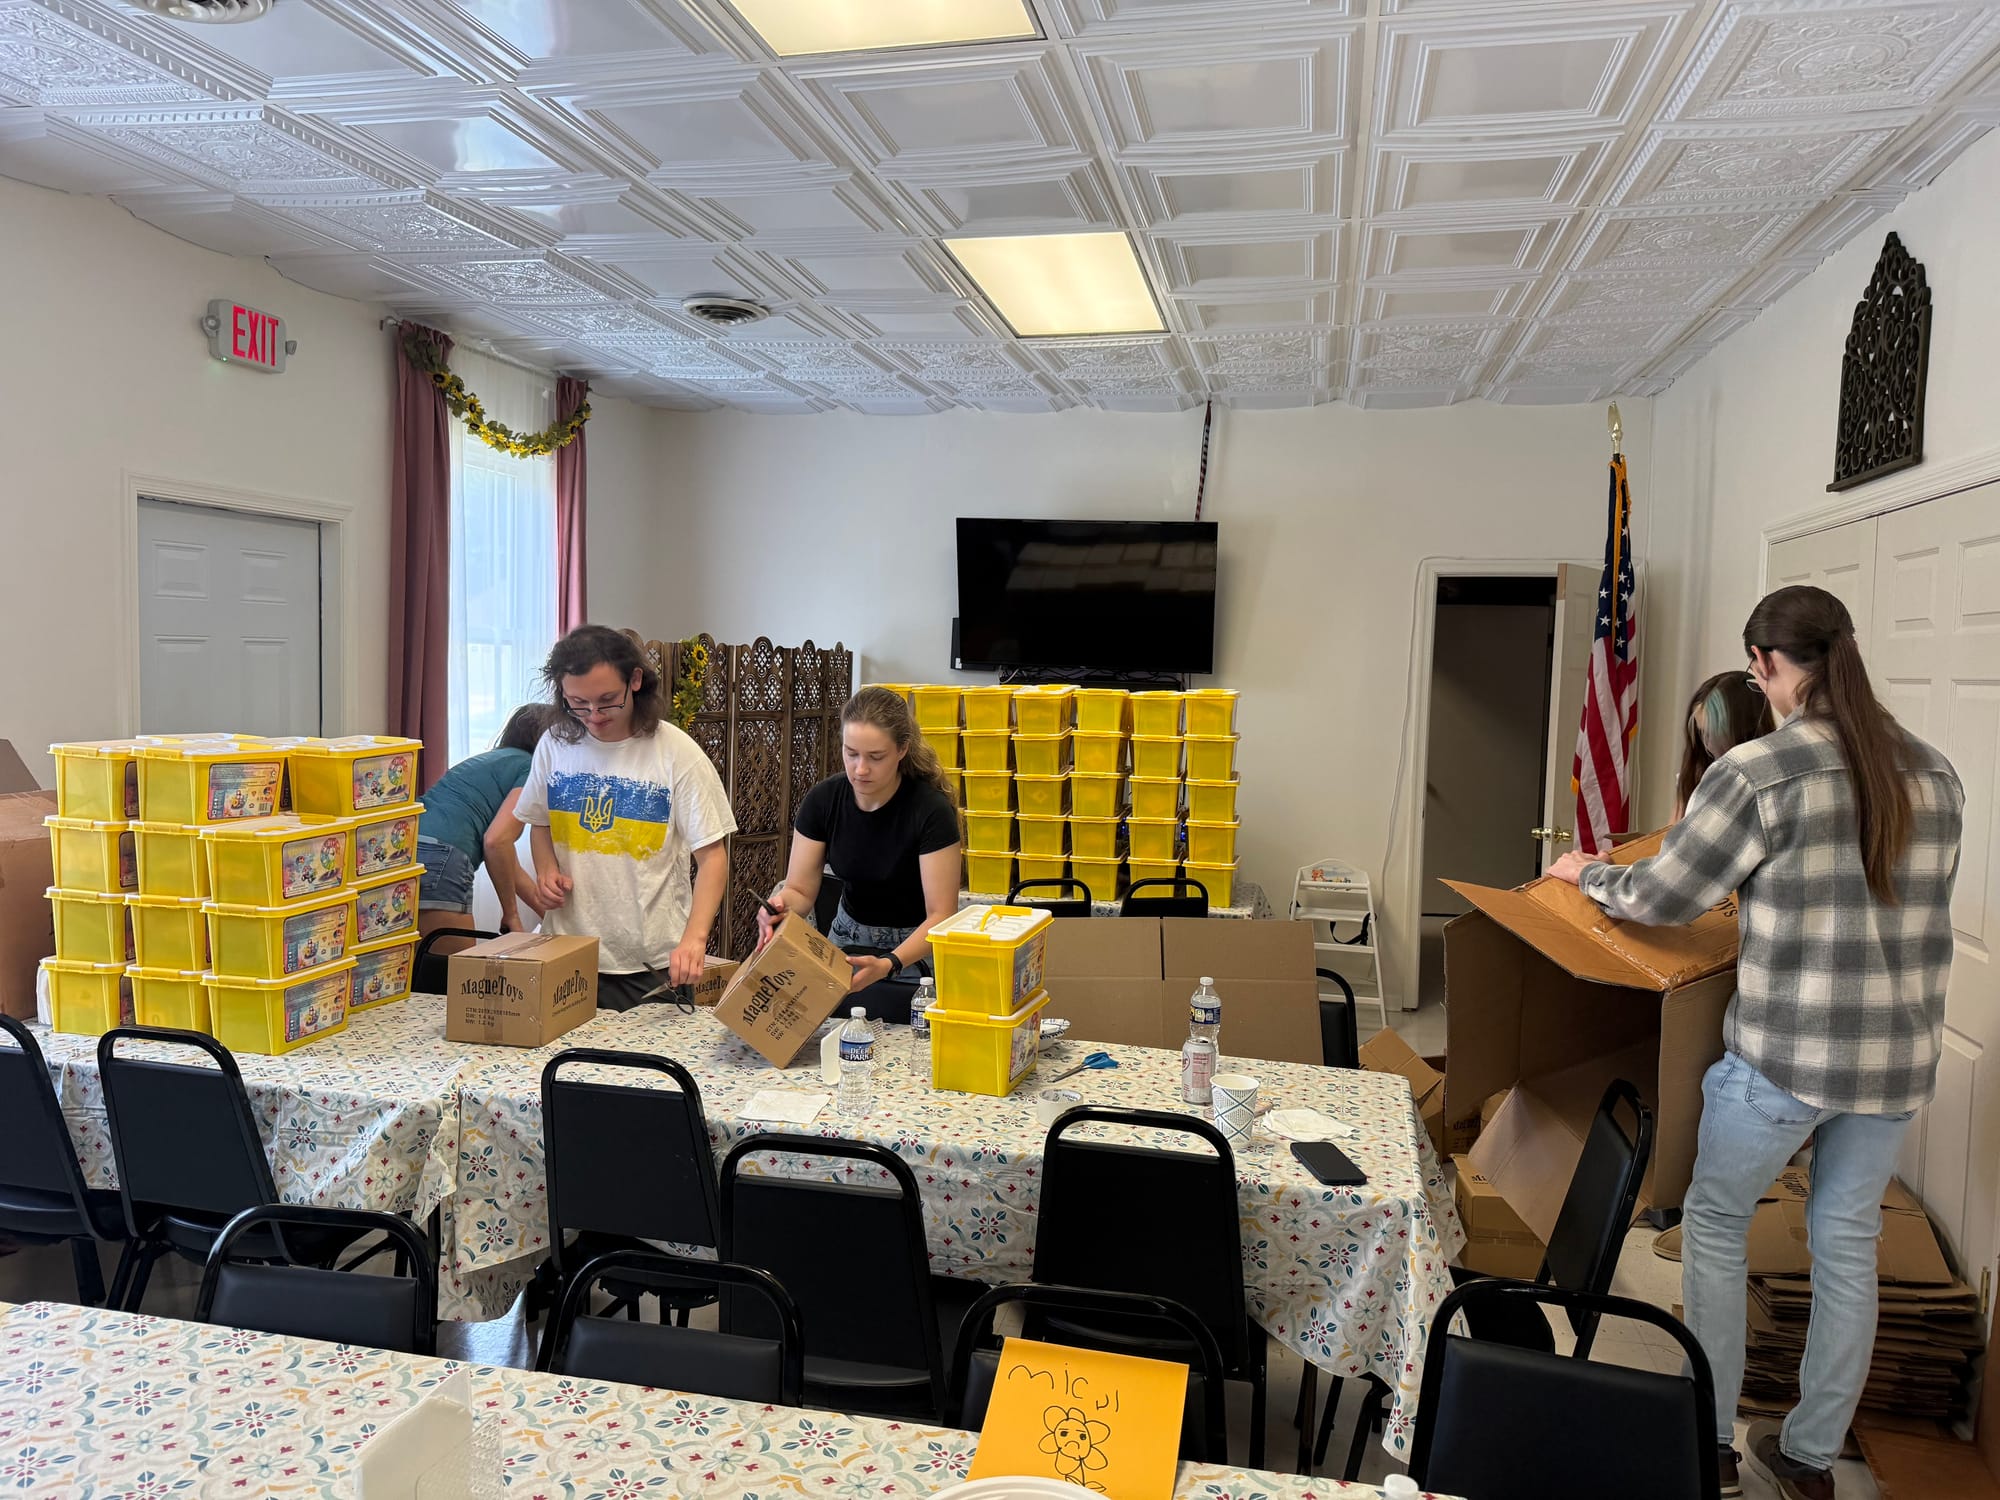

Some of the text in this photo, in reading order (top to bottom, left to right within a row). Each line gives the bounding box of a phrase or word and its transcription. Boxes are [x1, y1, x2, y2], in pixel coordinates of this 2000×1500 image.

[232, 304, 279, 367] EXIT
[461, 975, 524, 1002] MagneToys
[553, 970, 589, 1007] MagneToys
[695, 975, 728, 995] MagneTo
[743, 969, 796, 1027] MagneToys
[850, 1053, 869, 1061] PARK
